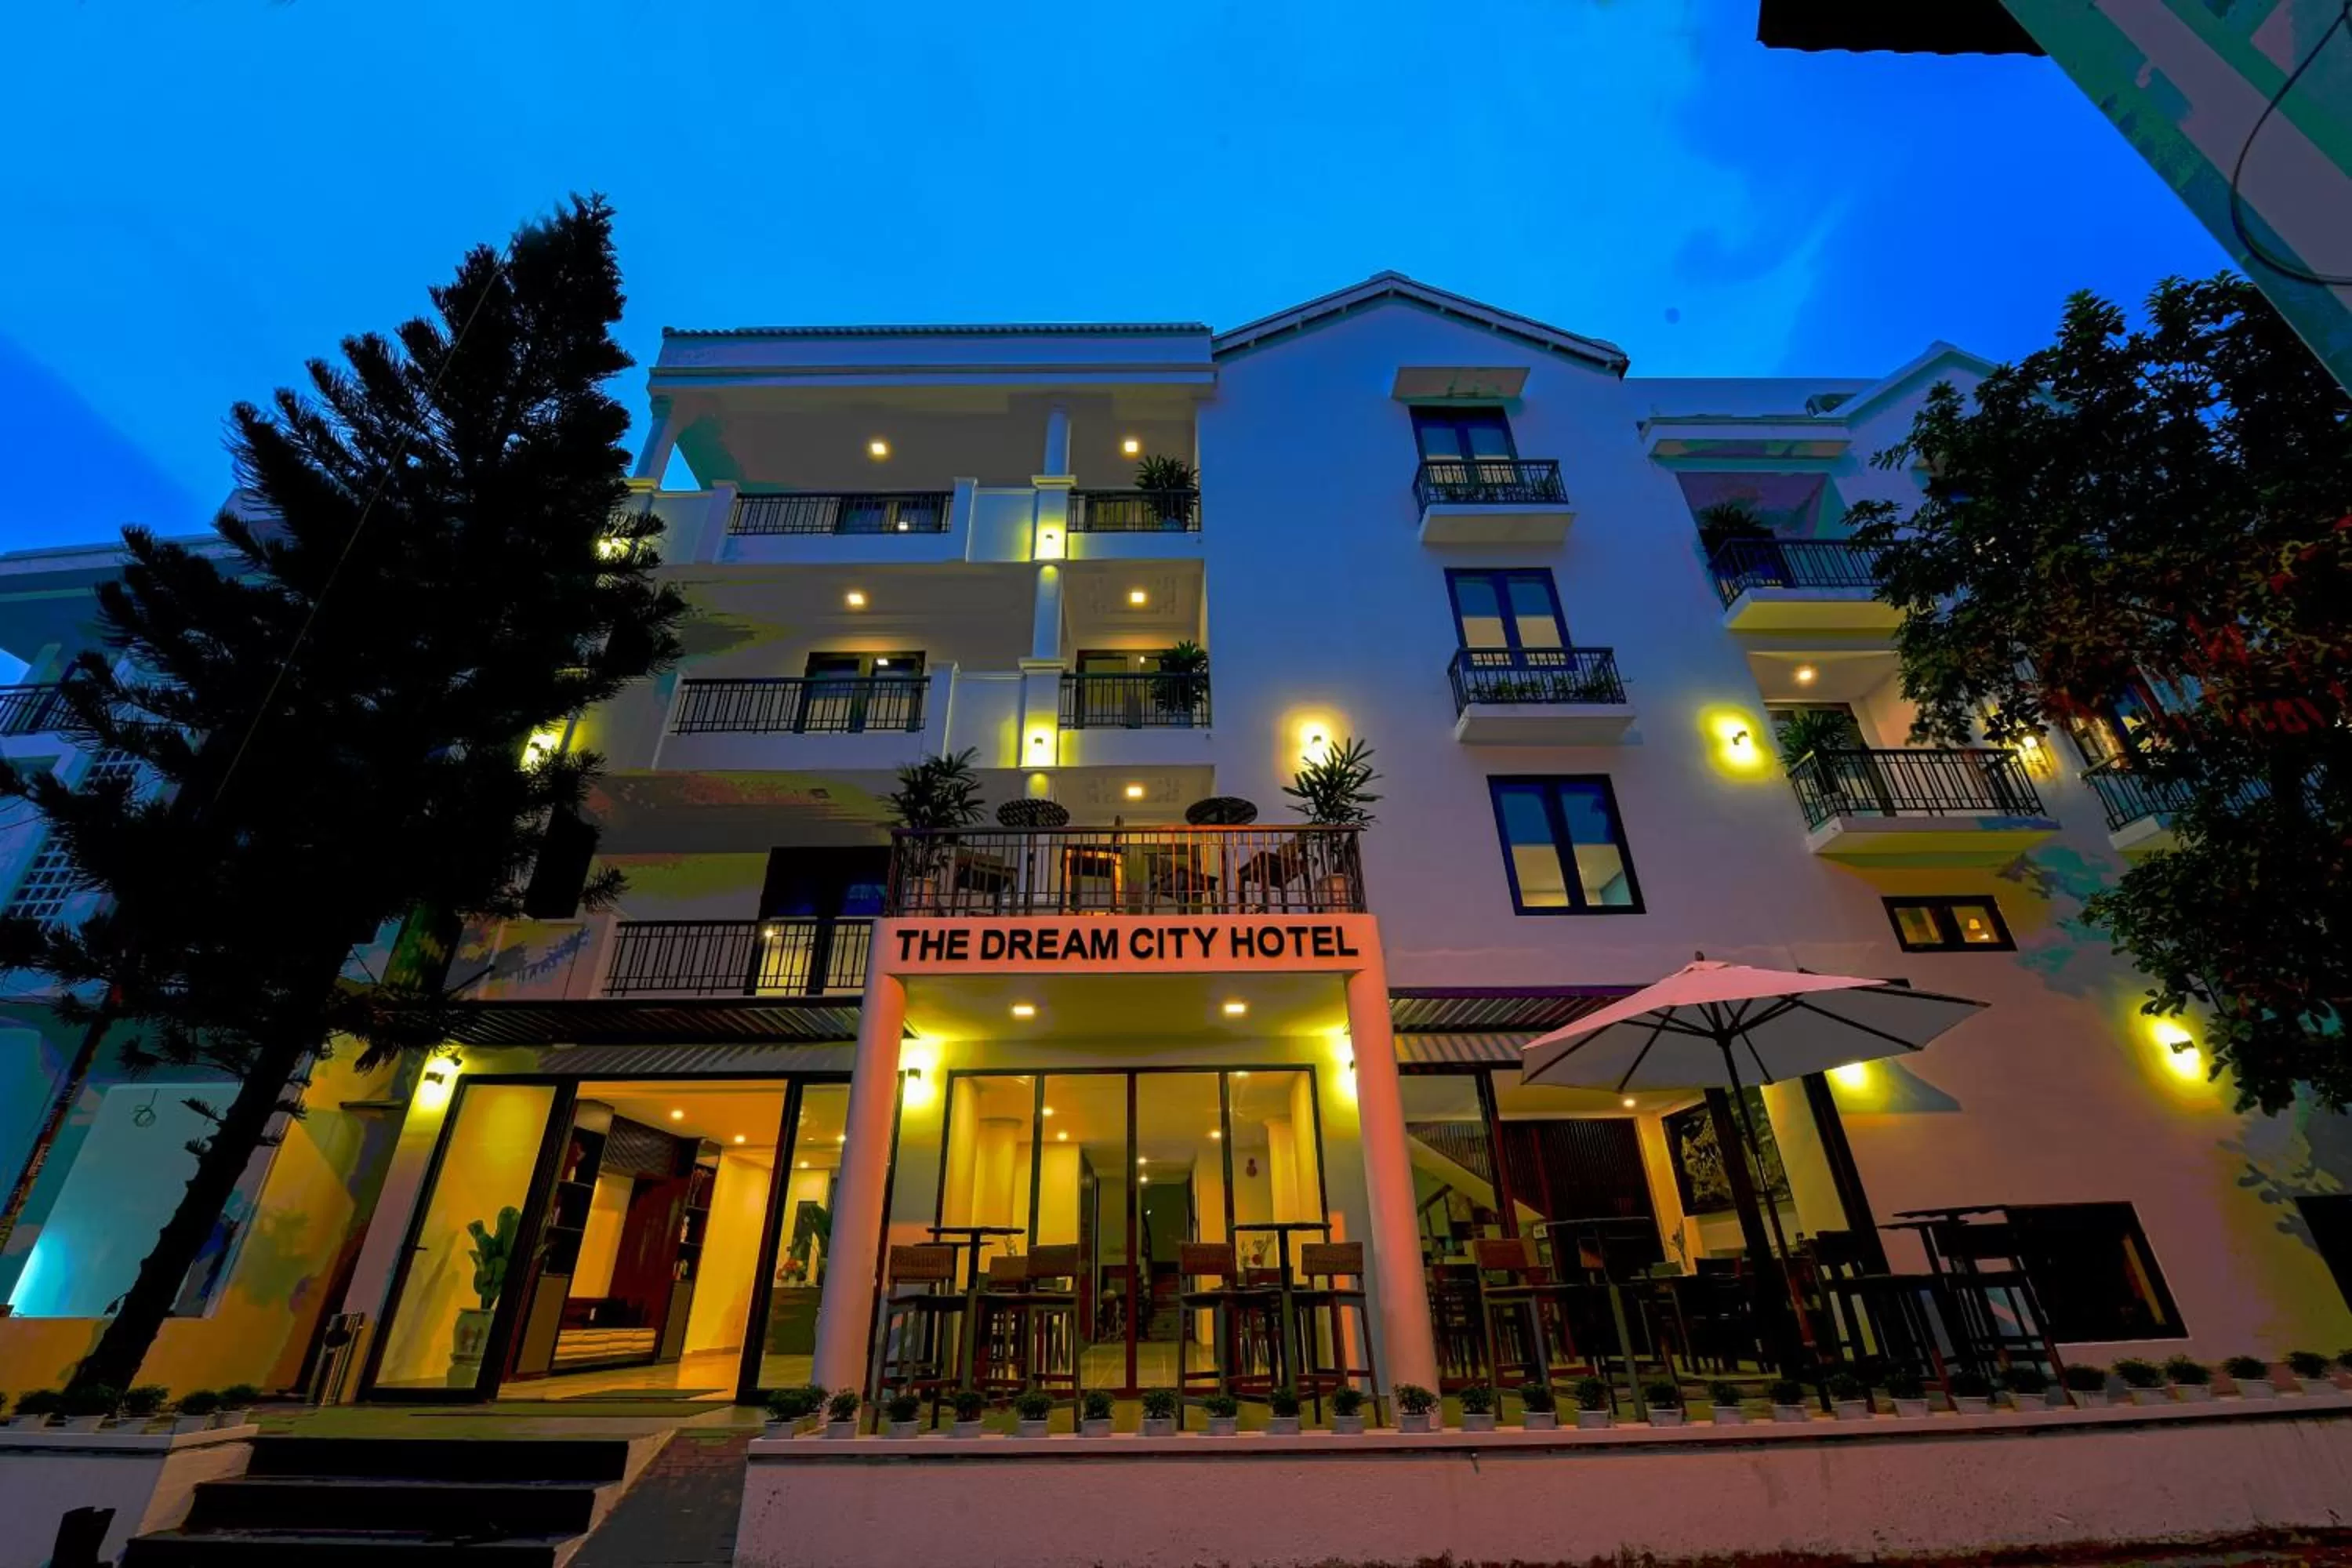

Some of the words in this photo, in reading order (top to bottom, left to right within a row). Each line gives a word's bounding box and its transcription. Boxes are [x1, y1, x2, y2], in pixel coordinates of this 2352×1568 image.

[896, 929, 971, 961] THE
[980, 928, 1119, 960] DREAM
[1129, 927, 1218, 960] CITY
[1230, 926, 1359, 958] HOTEL
